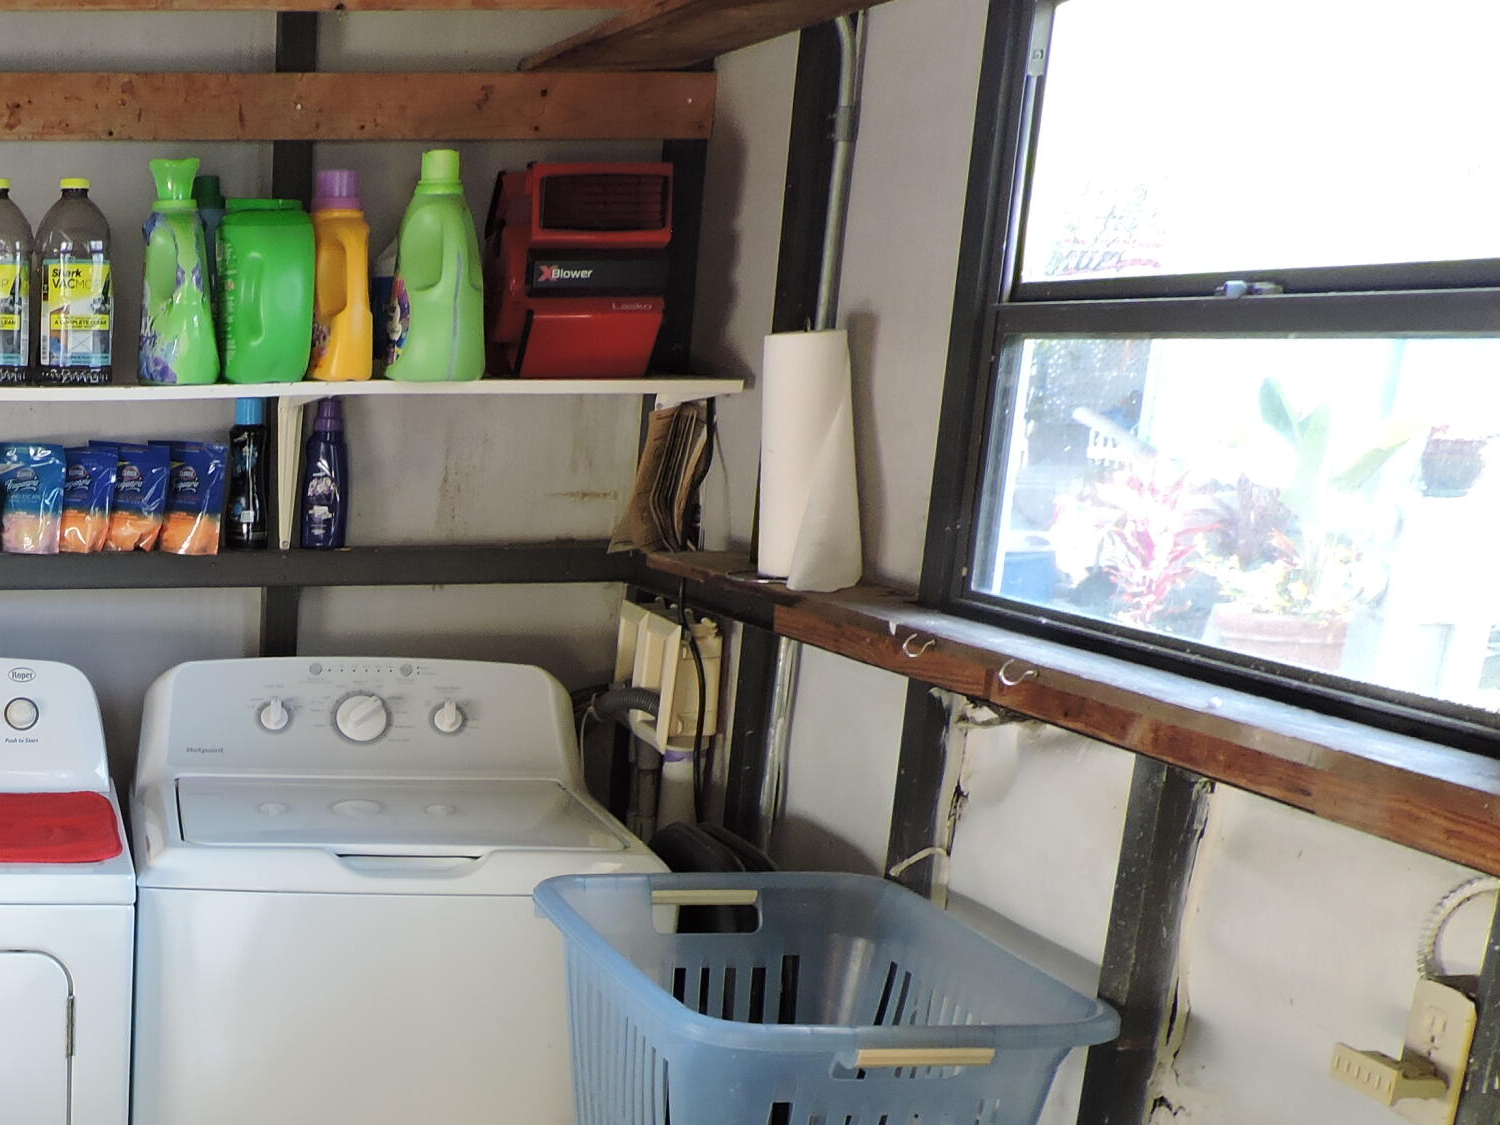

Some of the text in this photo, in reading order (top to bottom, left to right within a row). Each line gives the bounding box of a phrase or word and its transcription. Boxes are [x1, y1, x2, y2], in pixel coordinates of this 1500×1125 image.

[52, 268, 82, 278] Shark
[52, 278, 100, 289] VACMO
[11, 671, 34, 680] Roper
